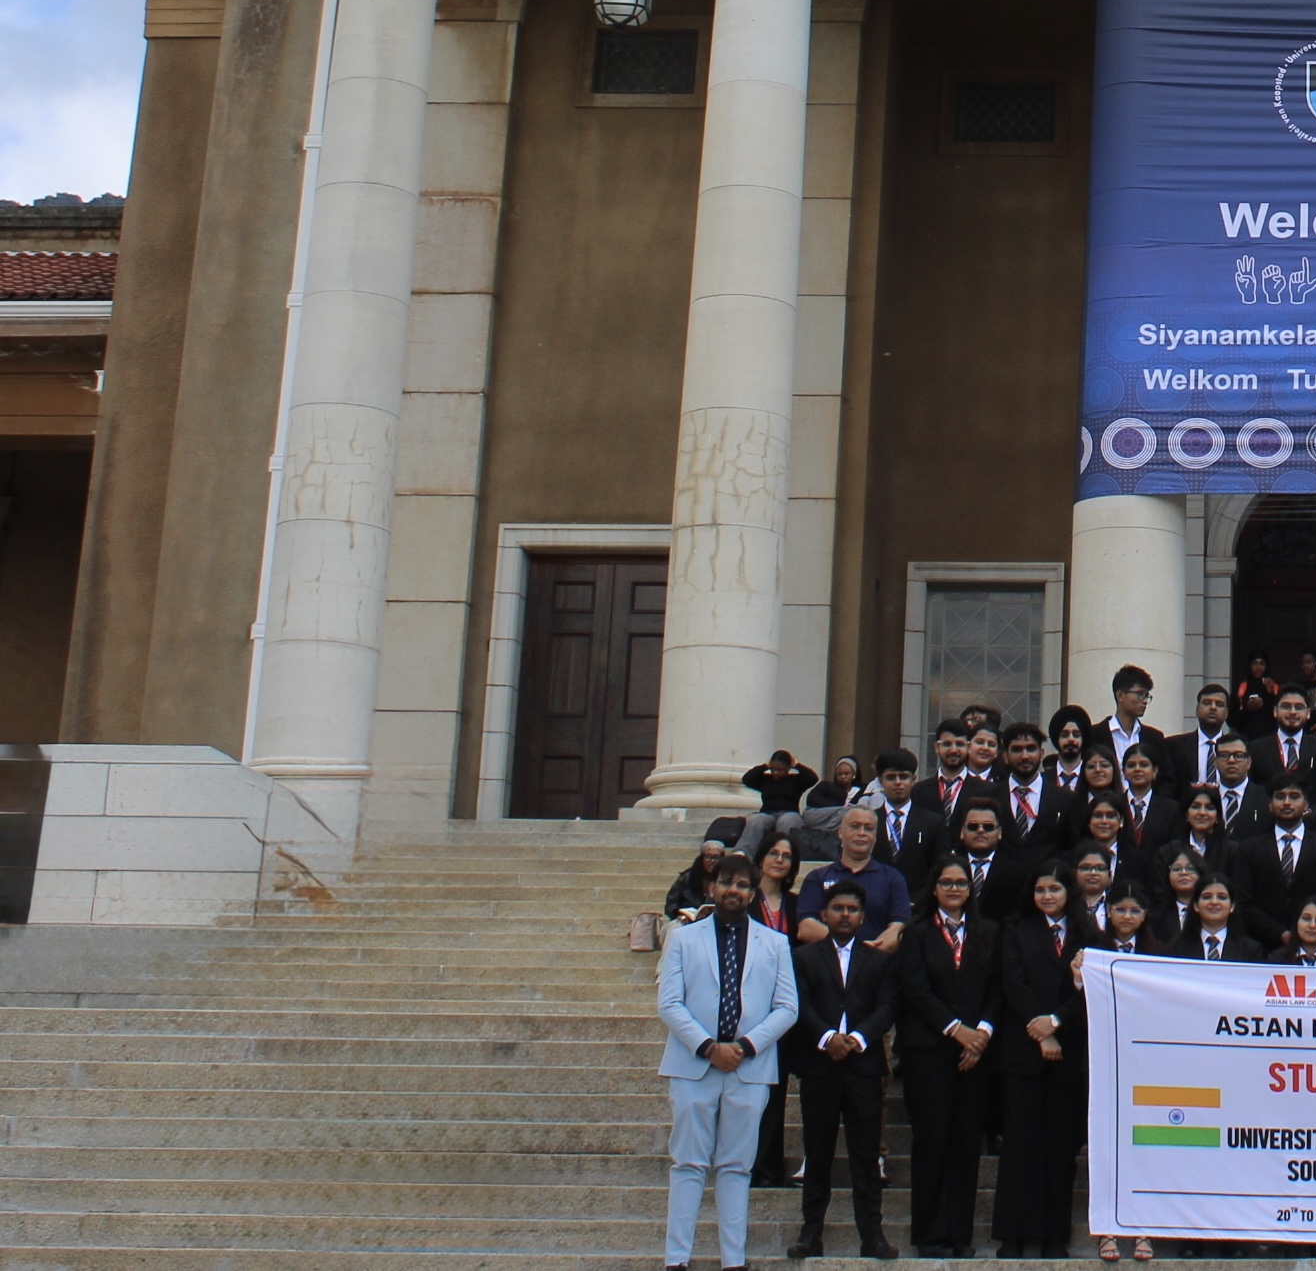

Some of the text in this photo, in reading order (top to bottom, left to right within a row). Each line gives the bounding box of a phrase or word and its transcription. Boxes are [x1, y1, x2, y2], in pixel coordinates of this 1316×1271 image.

[1278, 108, 1291, 125] van
[1143, 368, 1258, 390] Welkom
[1265, 998, 1288, 1006] ASIAN
[1289, 998, 1306, 1006] LAW
[1215, 1015, 1303, 1038] ASIAN
[1300, 1210, 1314, 1222] TO
